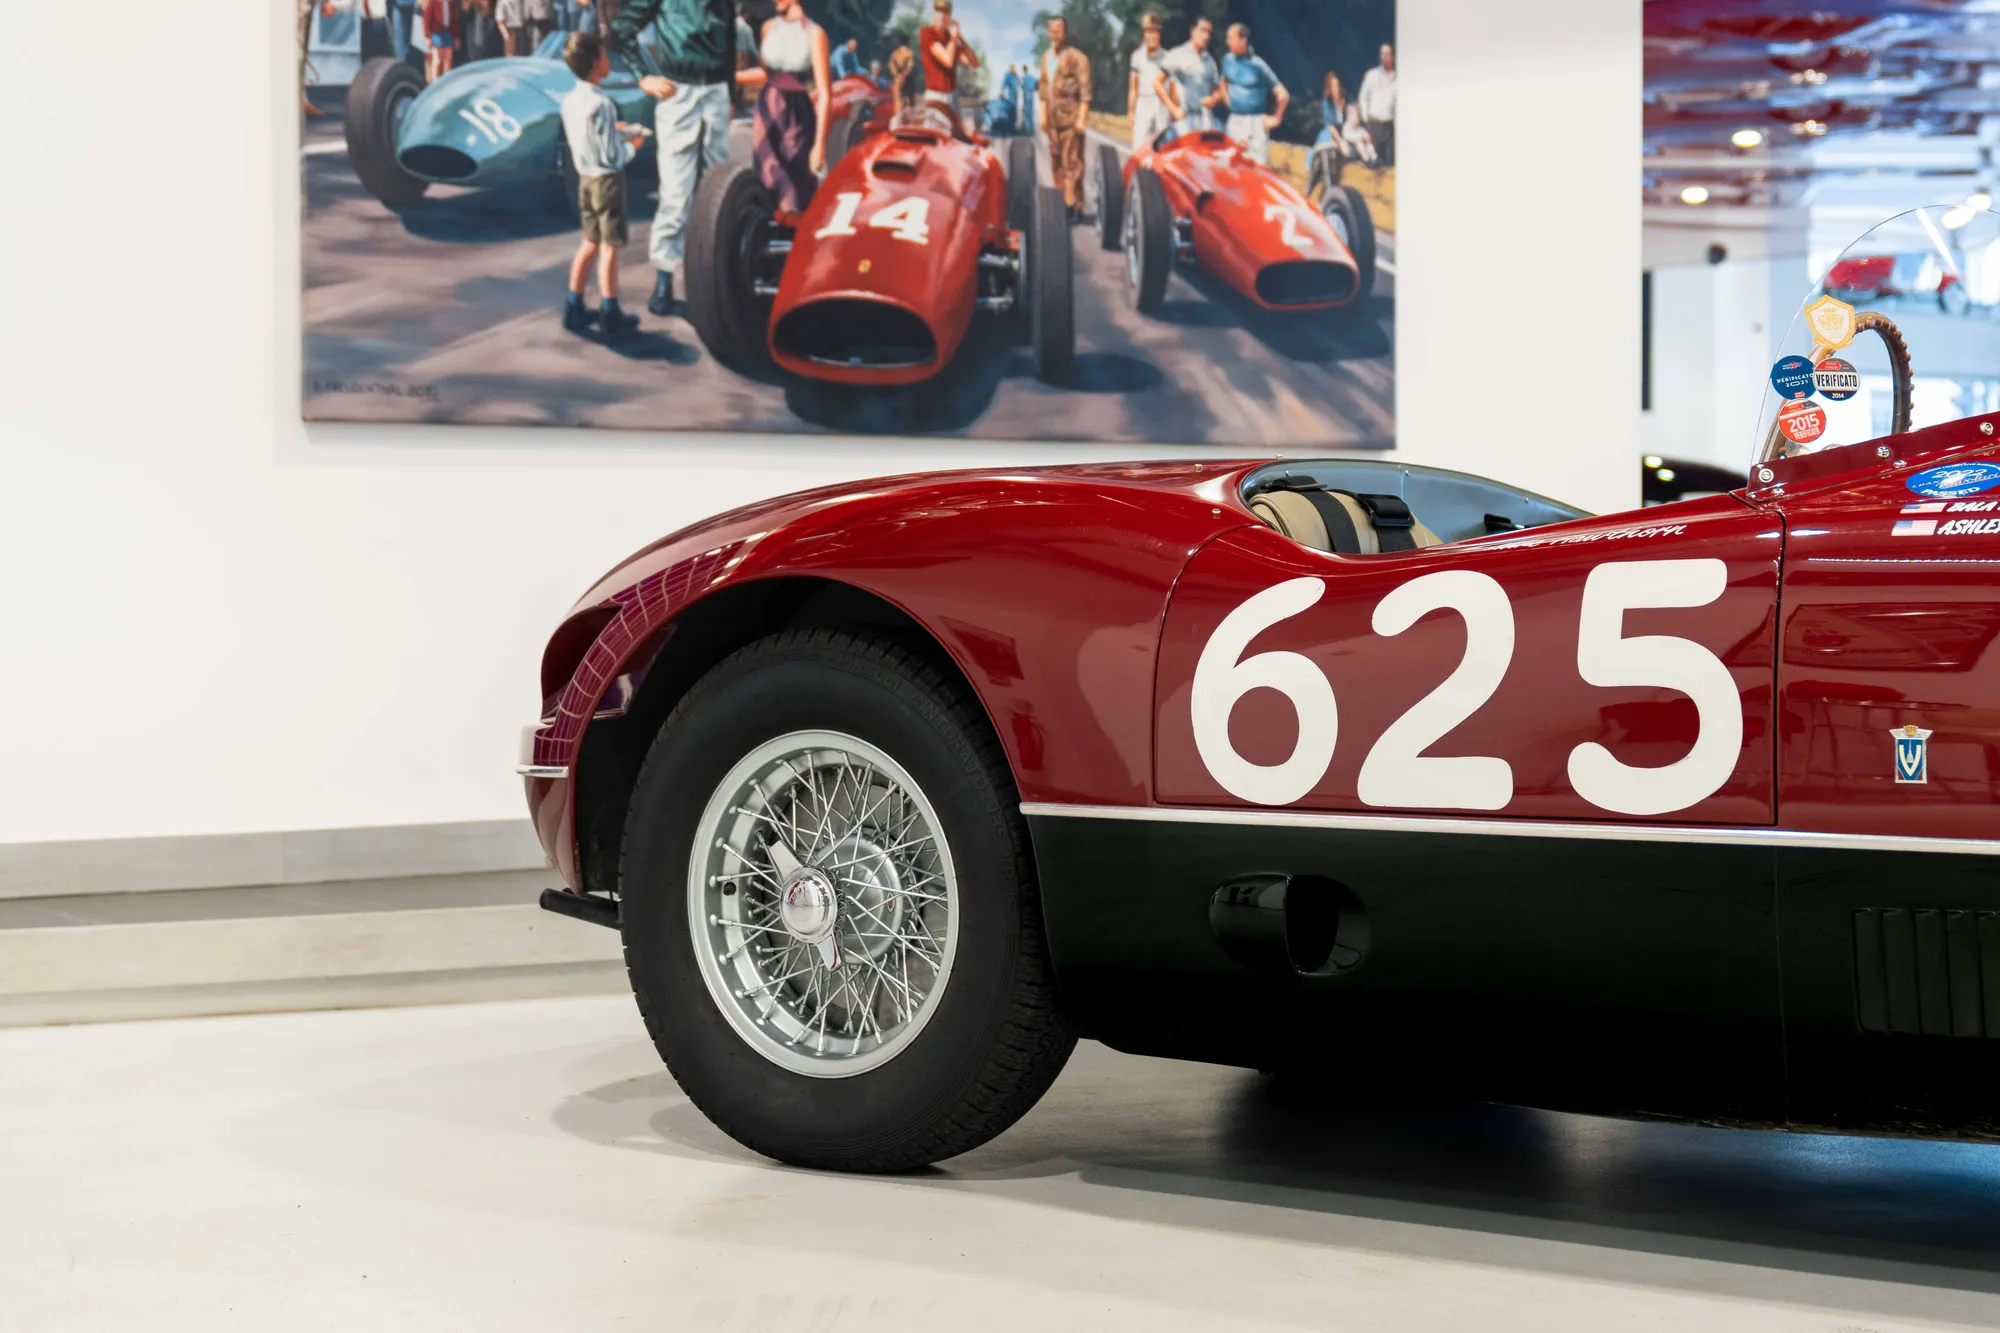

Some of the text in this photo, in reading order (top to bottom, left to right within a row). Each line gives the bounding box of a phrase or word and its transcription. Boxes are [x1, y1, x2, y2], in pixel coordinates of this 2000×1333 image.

[814, 192, 930, 245] 14
[1264, 204, 1315, 246] 2
[1815, 374, 1858, 388] VERIFICATO
[1787, 413, 1820, 434] 2015
[1792, 427, 1820, 440] VERIFICATO
[1920, 486, 1981, 497] PASSED
[1946, 501, 1998, 512] BALA
[1190, 558, 1743, 815] 625
